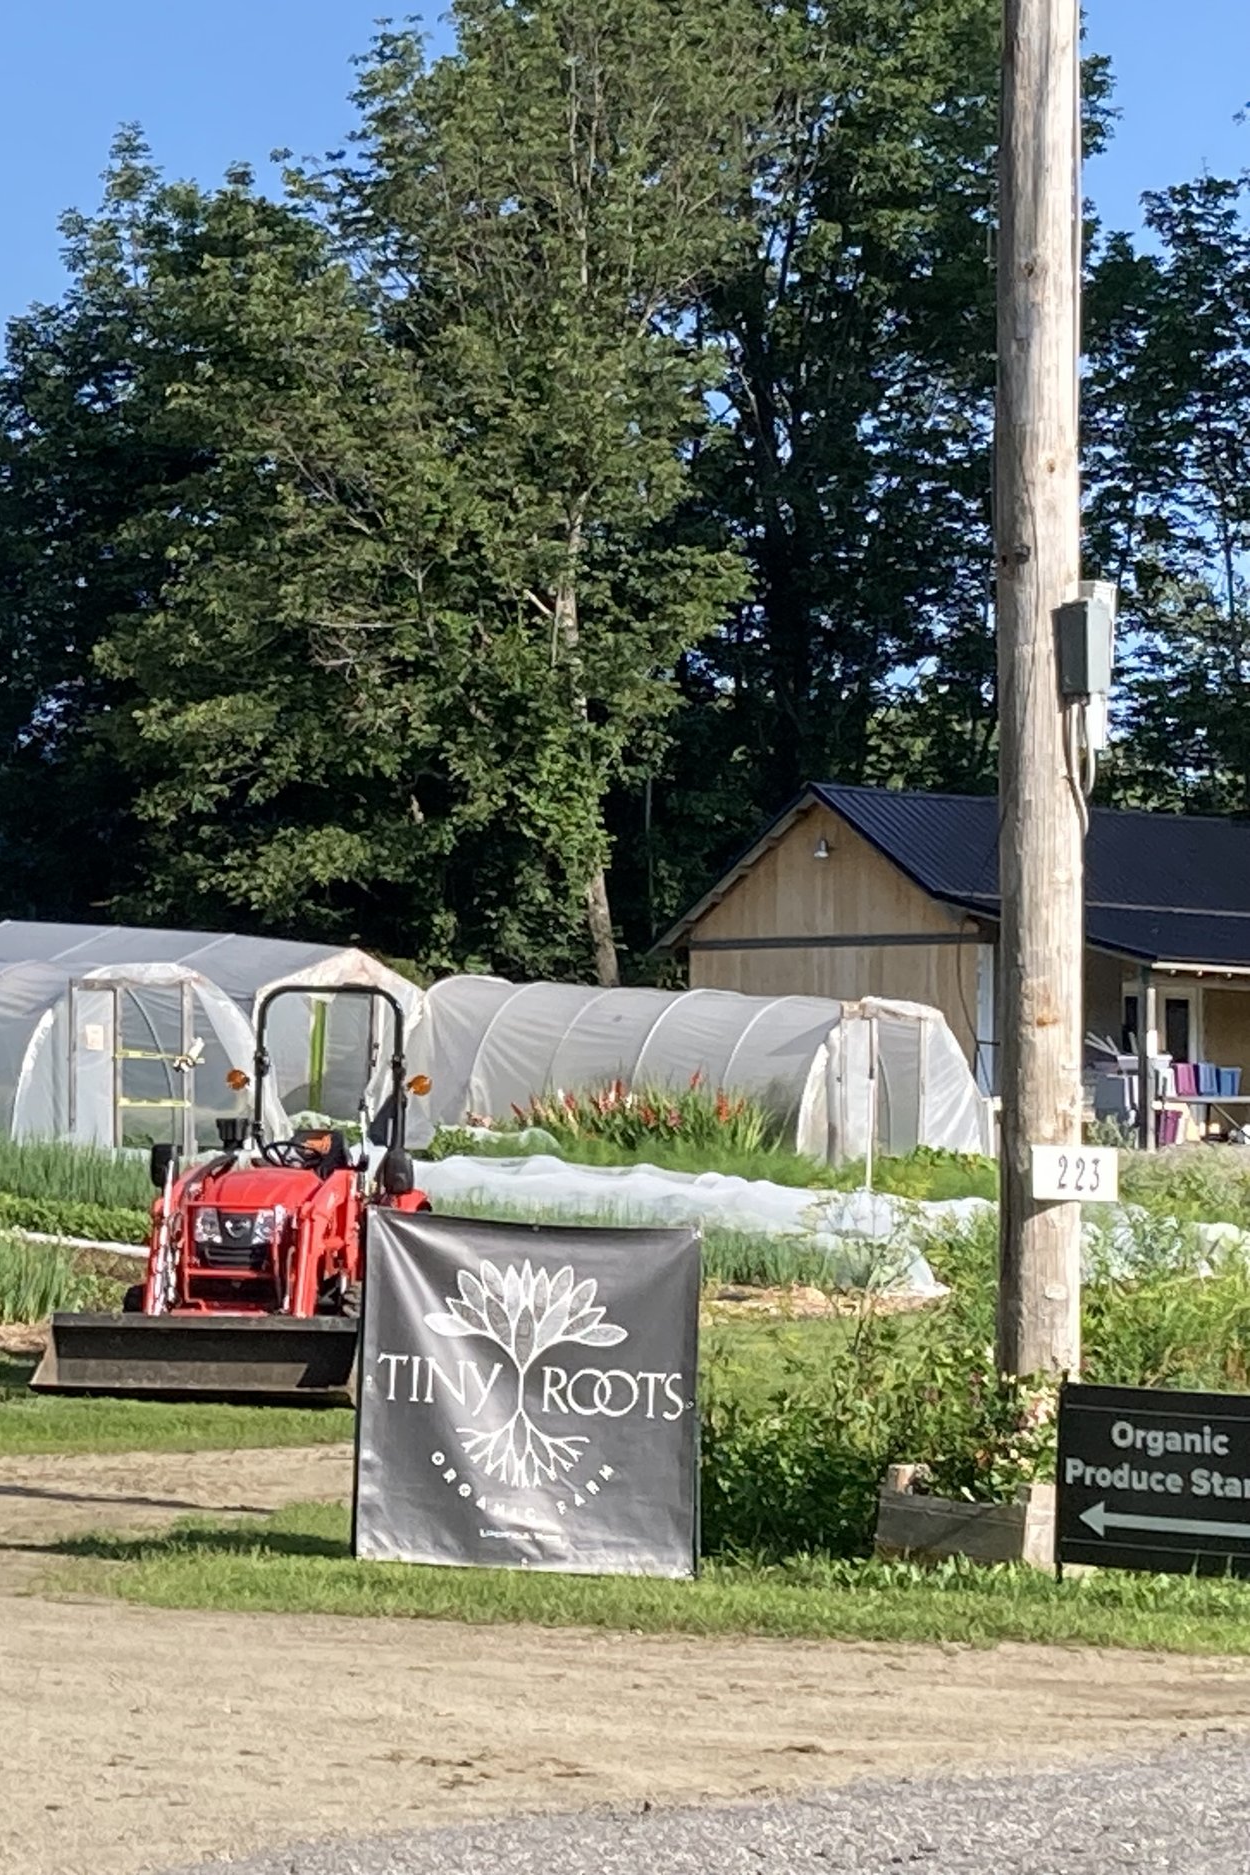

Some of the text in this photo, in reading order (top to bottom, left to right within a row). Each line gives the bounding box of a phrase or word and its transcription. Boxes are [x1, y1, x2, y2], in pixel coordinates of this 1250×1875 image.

[1056, 1153, 1101, 1193] 223
[376, 1353, 684, 1421] TINY ROOTS
[1111, 1420, 1230, 1457] Organic
[431, 1451, 615, 1521] ORGANIC FARM
[1065, 1457, 1184, 1494] Produce
